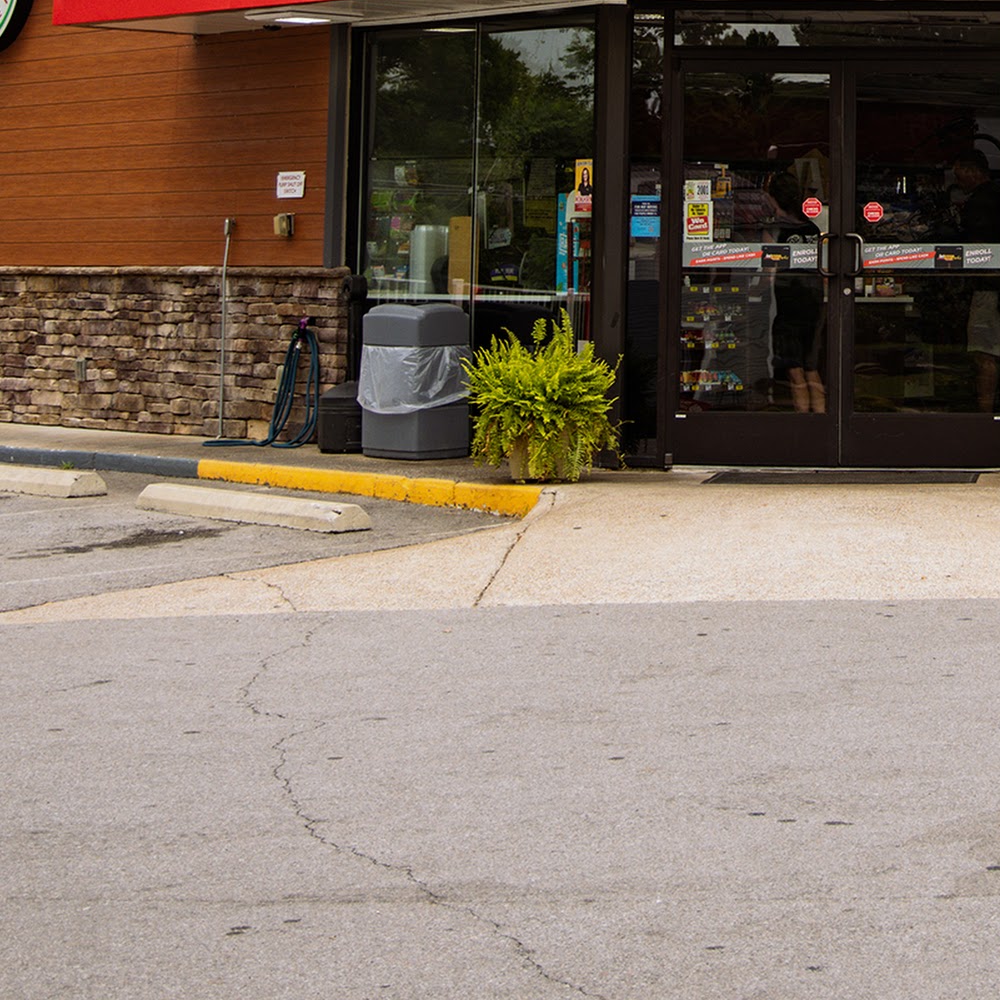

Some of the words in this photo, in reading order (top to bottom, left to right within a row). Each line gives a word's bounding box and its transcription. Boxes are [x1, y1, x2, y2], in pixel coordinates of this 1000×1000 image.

[688, 222, 708, 230] Card
[965, 248, 992, 257] ENROLL
[966, 255, 992, 264] TODAY!
